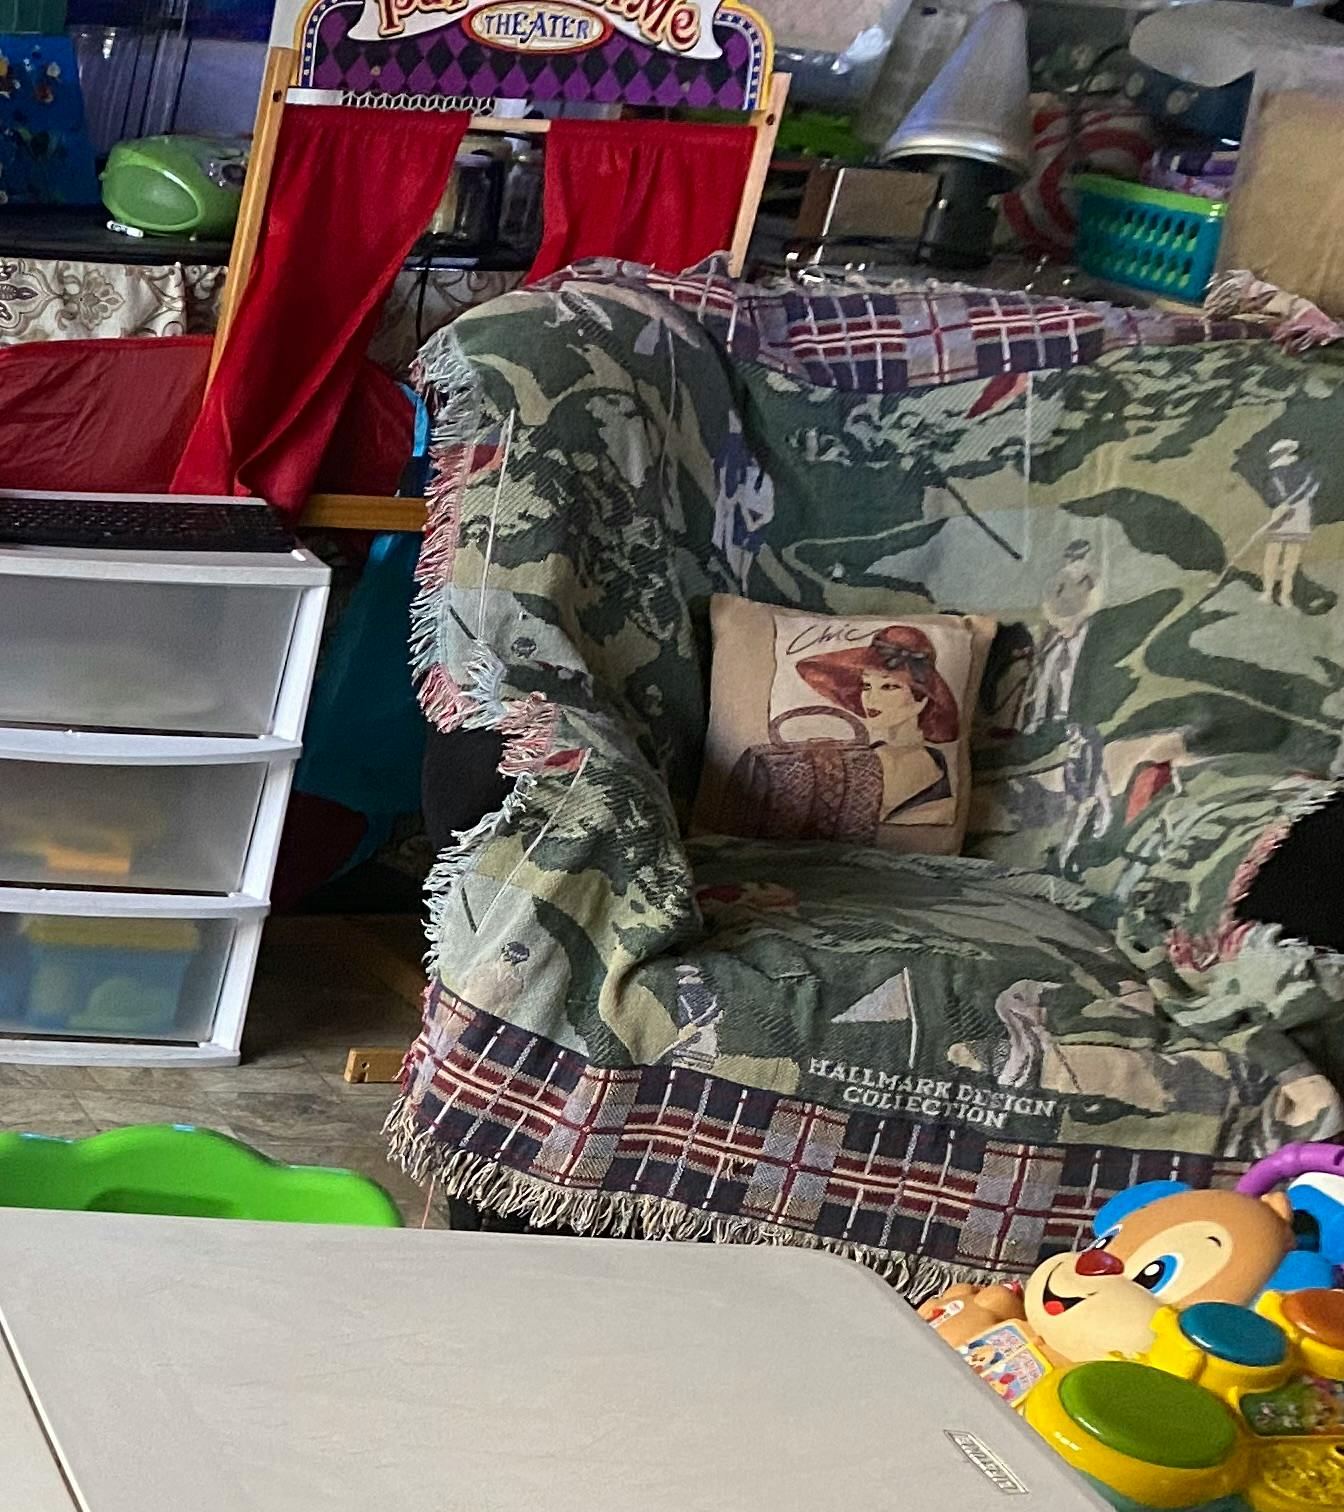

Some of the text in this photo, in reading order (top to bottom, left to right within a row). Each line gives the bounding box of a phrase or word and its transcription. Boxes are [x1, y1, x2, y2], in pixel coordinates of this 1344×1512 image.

[485, 11, 591, 44] THEATER
[785, 624, 879, 656] Chic
[808, 1056, 1057, 1117] HALLMARK DESIGN
[843, 1086, 1008, 1128] COLLECTION
